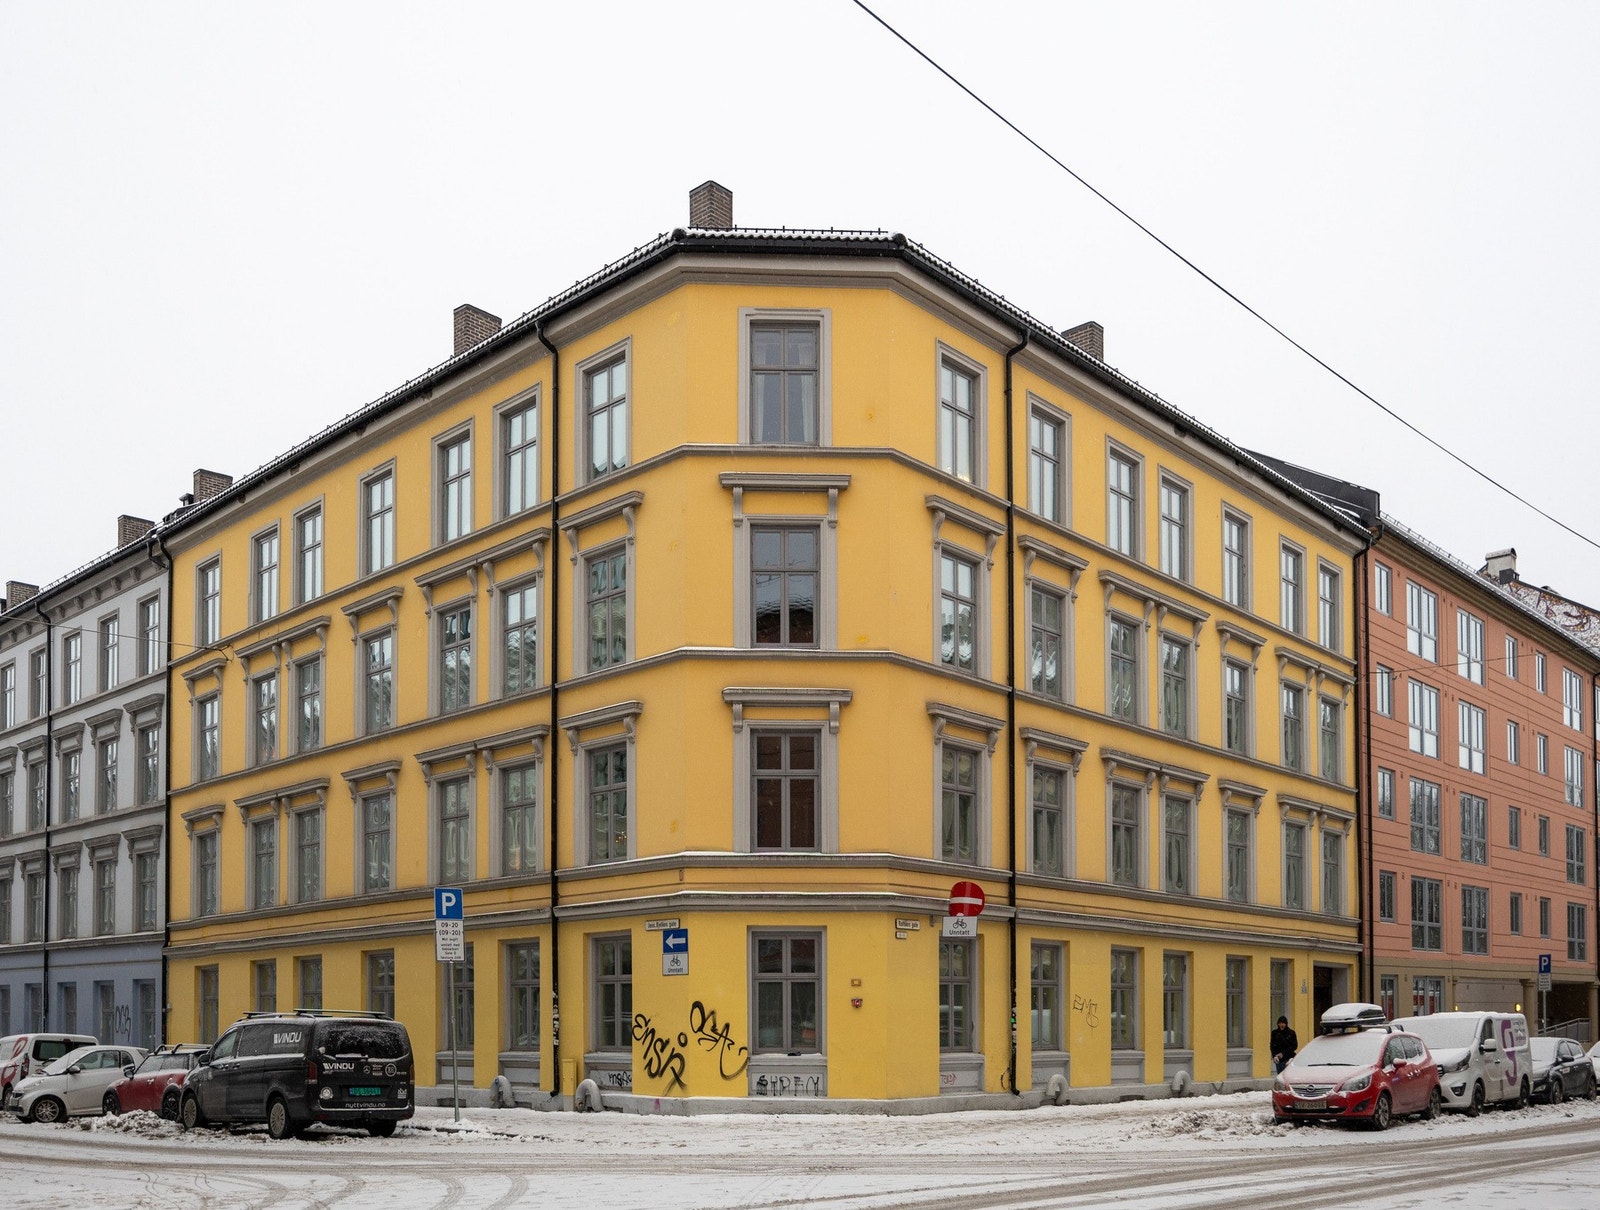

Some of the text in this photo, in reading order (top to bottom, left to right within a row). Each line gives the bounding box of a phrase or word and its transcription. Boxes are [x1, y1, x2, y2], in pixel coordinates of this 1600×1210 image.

[442, 893, 456, 915] P
[1541, 957, 1549, 971] P
[277, 1032, 302, 1044] VINDU
